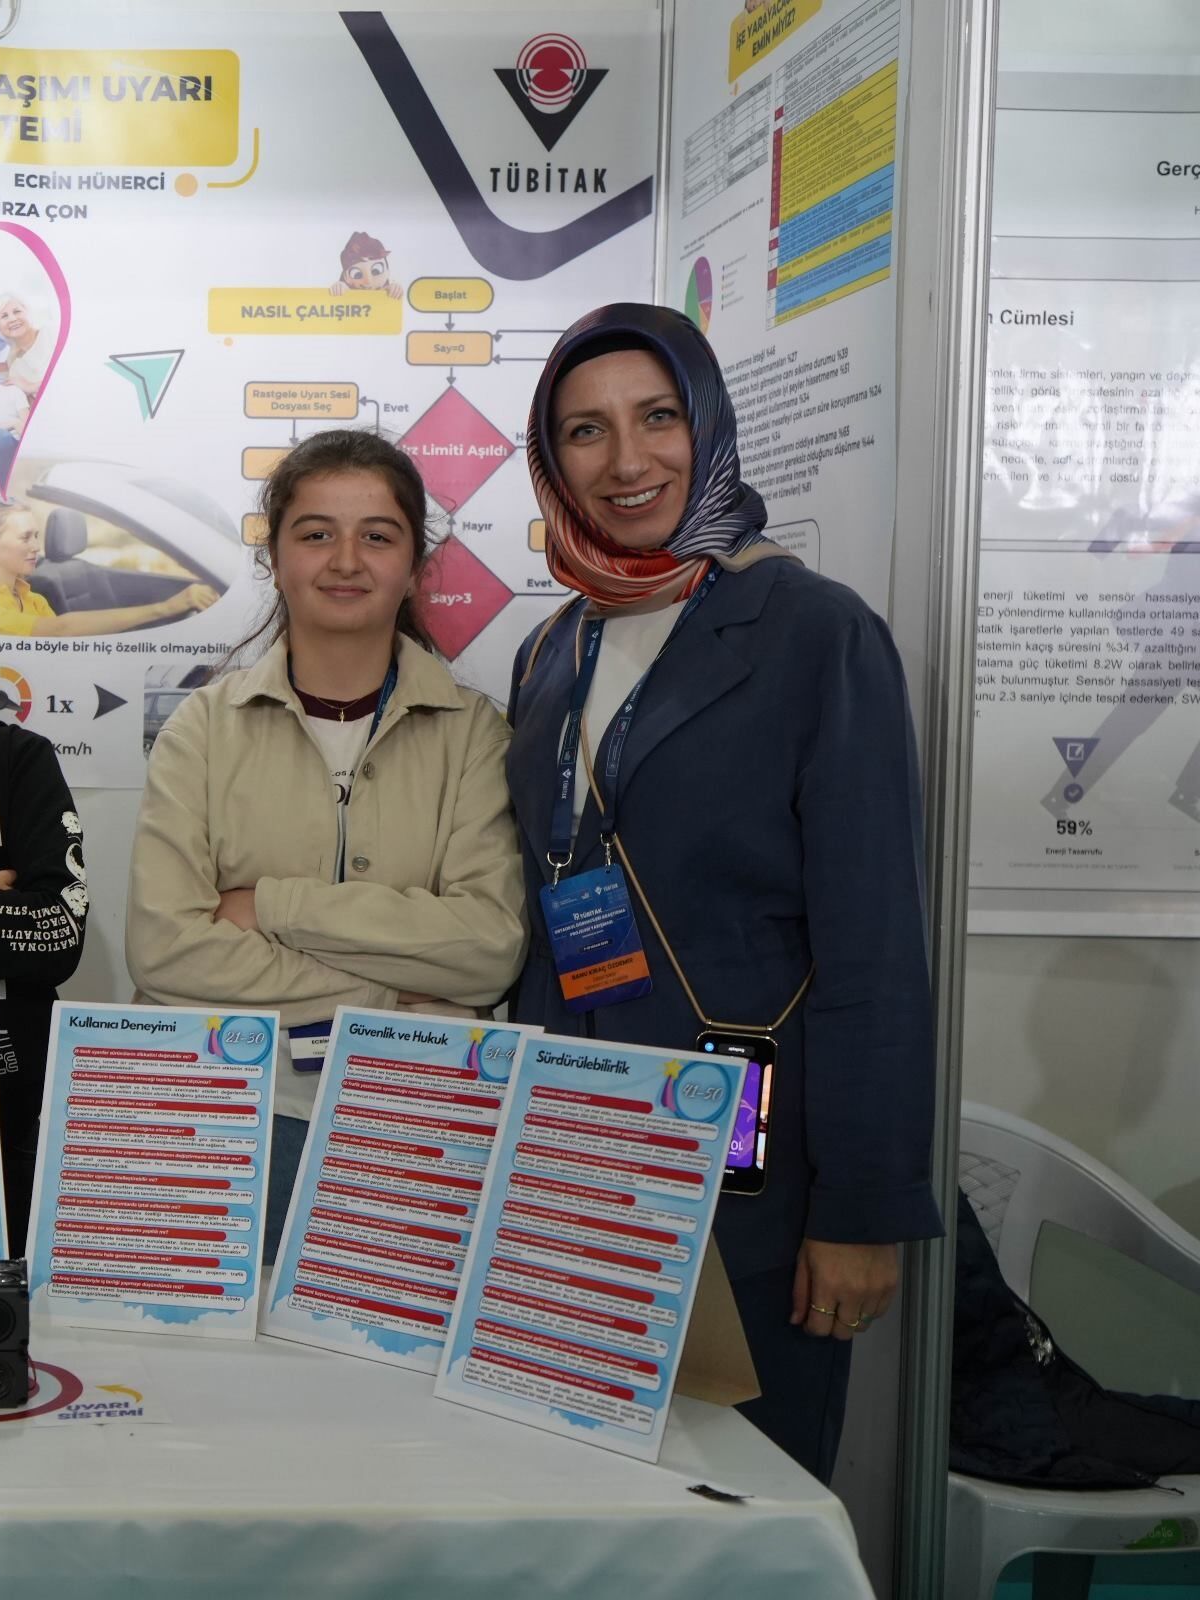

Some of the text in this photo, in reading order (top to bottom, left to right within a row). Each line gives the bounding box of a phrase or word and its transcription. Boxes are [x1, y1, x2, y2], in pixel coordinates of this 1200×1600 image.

[752, 8, 796, 57] EMİN MİYİZ?
[103, 75, 212, 102] UYARI
[490, 162, 607, 193] TÜBİTAK
[1157, 160, 1200, 180] Gerç
[15, 171, 164, 191] ECRİN HÜNERCİ
[46, 204, 87, 221] ÇON
[434, 290, 467, 302] Başlat
[241, 305, 371, 322] NASIL ÇALIŞIR?
[1000, 309, 1075, 326] Cümlesi
[433, 343, 465, 355] Say=0
[253, 390, 351, 402] Rastgele Uyarı Sesi
[271, 402, 333, 413] Dosyası Seç
[383, 403, 409, 413] Evet
[422, 444, 507, 459] Limiti Aşıldı
[462, 521, 493, 533] Hayır
[527, 578, 552, 588] Evet
[430, 593, 472, 605] Say>3
[16, 640, 31, 651] da
[35, 640, 69, 654] böyle
[73, 641, 89, 652] bir
[94, 641, 112, 655] hiç
[116, 641, 156, 654] özellik
[1094, 659, 1122, 670] 8.2W
[1076, 675, 1114, 686] Sensör
[47, 695, 74, 714] 1x
[1056, 819, 1093, 835] 59%
[10, 937, 76, 952] NATIONAL
[69, 1016, 265, 1043] Kullanıcı Deneyimi 21-30
[349, 1023, 517, 1061] Güvenlik ve Hukuk 31-4
[536, 1049, 630, 1076] Sürdürülebilirlik
[57, 1407, 144, 1421] SİSTEMİ
[66, 1401, 130, 1412] UYARI
